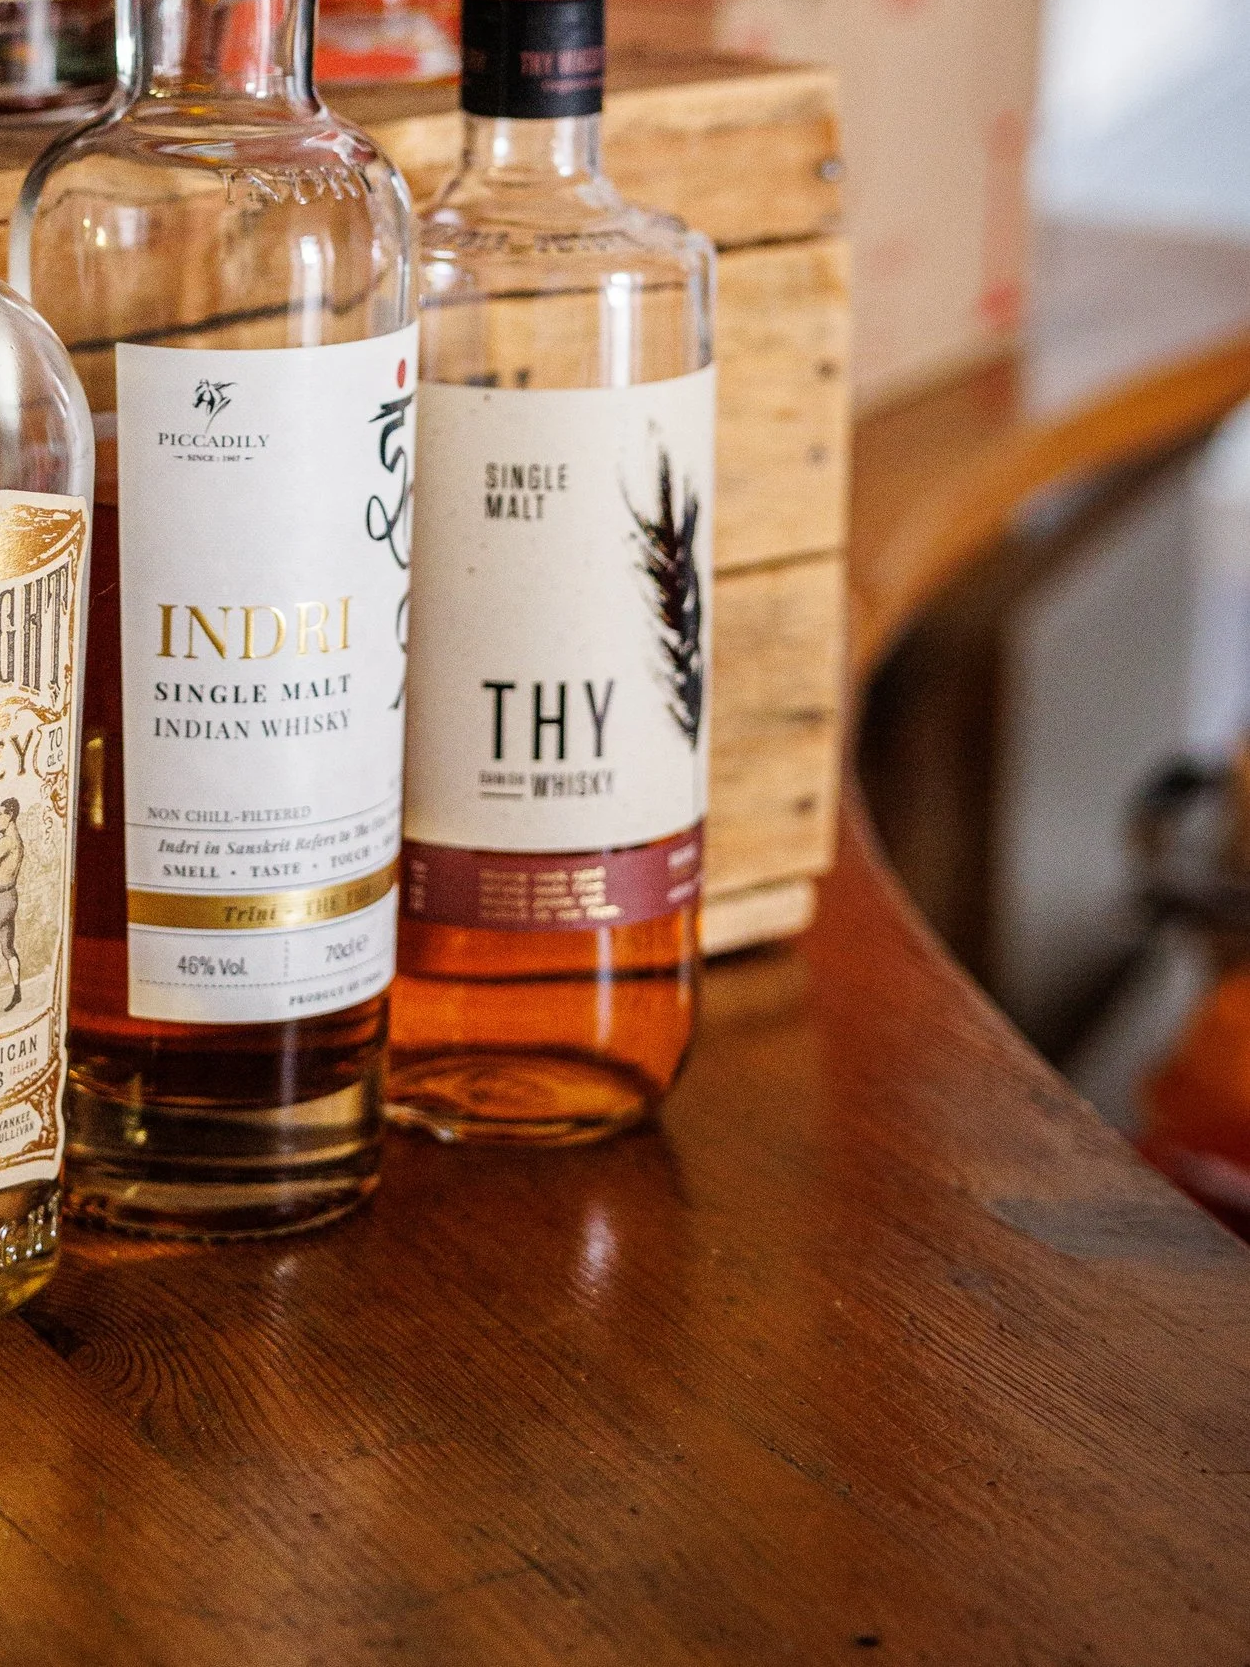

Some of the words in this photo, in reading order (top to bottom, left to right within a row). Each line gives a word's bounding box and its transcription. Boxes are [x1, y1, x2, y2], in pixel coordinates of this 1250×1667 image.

[158, 432, 270, 449] PICCADILY
[485, 461, 569, 491] SINGLE
[485, 493, 545, 521] MALT
[156, 596, 352, 660] INDRI
[155, 681, 267, 704] SINGLE
[281, 673, 351, 702] MALT
[154, 717, 249, 740] INDIAN
[262, 708, 351, 738] WHISKY
[482, 678, 615, 760] THY
[49, 726, 63, 751] 70
[531, 770, 614, 798] WHISKY
[147, 807, 180, 822] NON
[185, 805, 312, 823] CHILL-FILTERED
[158, 839, 200, 854] Indri
[204, 841, 220, 855] in
[227, 838, 291, 855] Sanskrit
[163, 864, 220, 879] SMELL
[250, 862, 302, 878] TASTE
[178, 955, 215, 976] 46%
